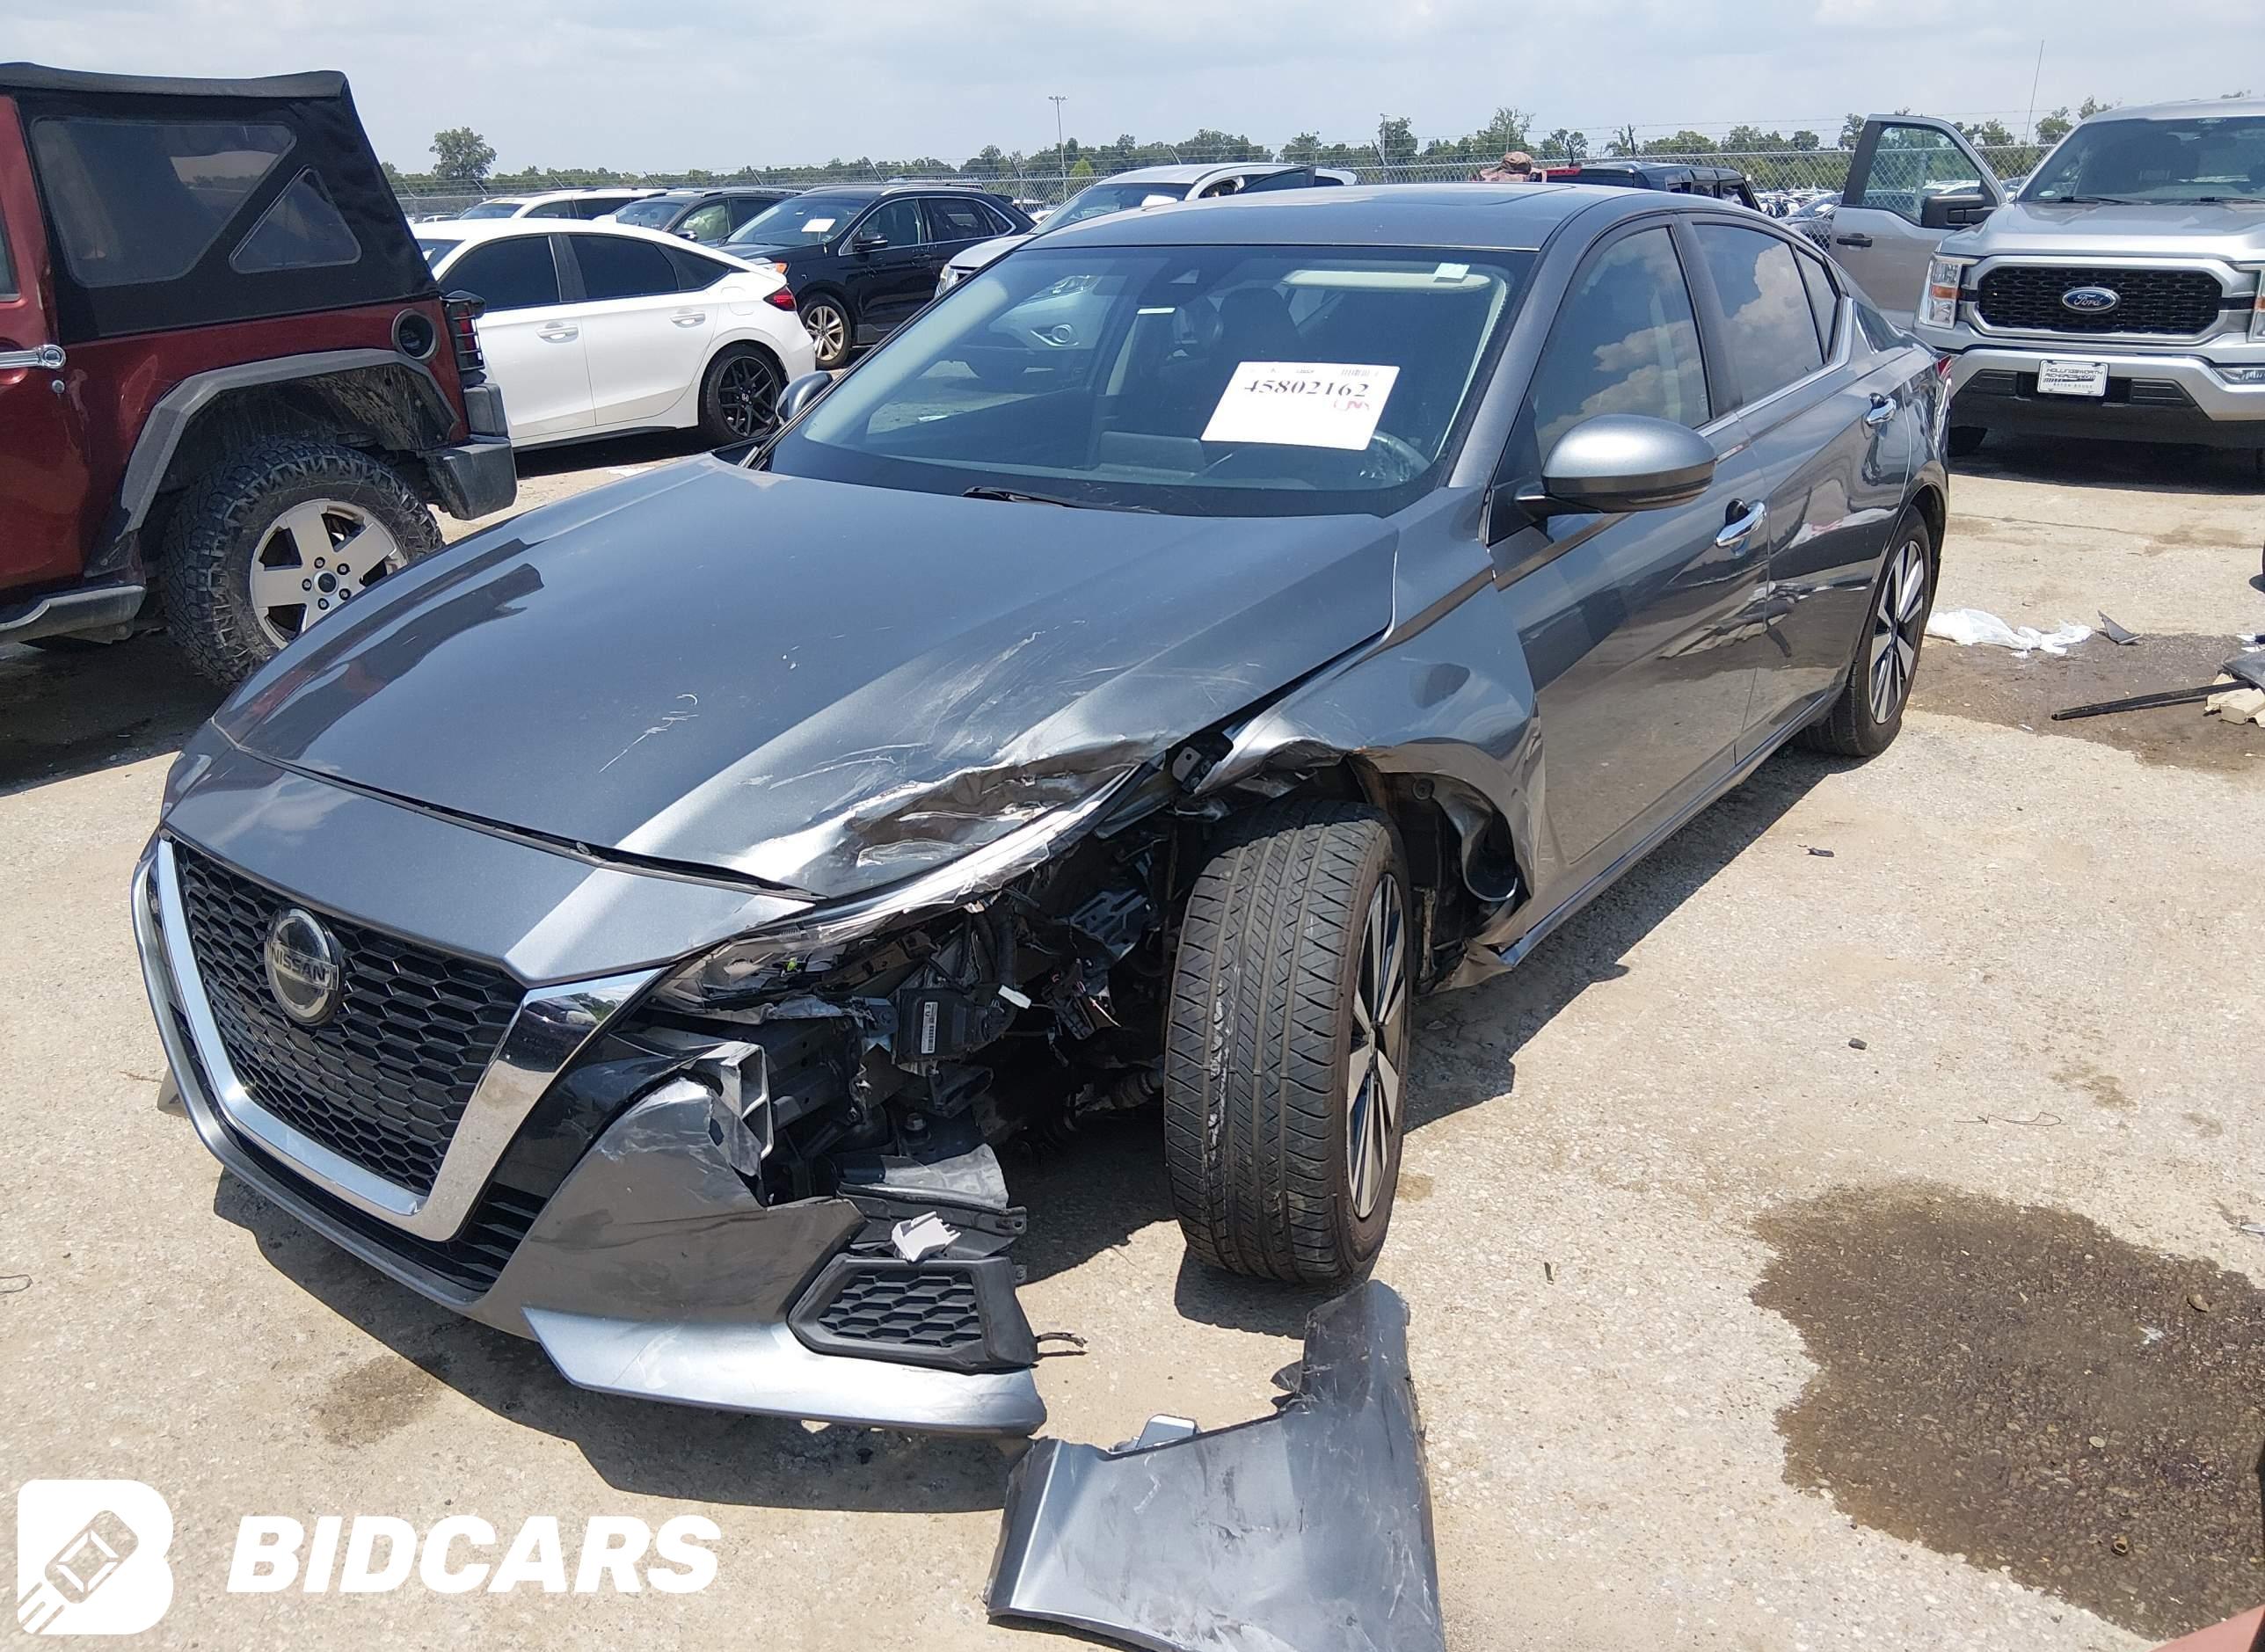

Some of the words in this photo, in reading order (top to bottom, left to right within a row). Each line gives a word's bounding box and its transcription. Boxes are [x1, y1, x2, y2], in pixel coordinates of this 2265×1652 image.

[2073, 294, 2102, 306] Ford
[1244, 379, 1369, 397] 45802162
[272, 947, 326, 981] NISSAN
